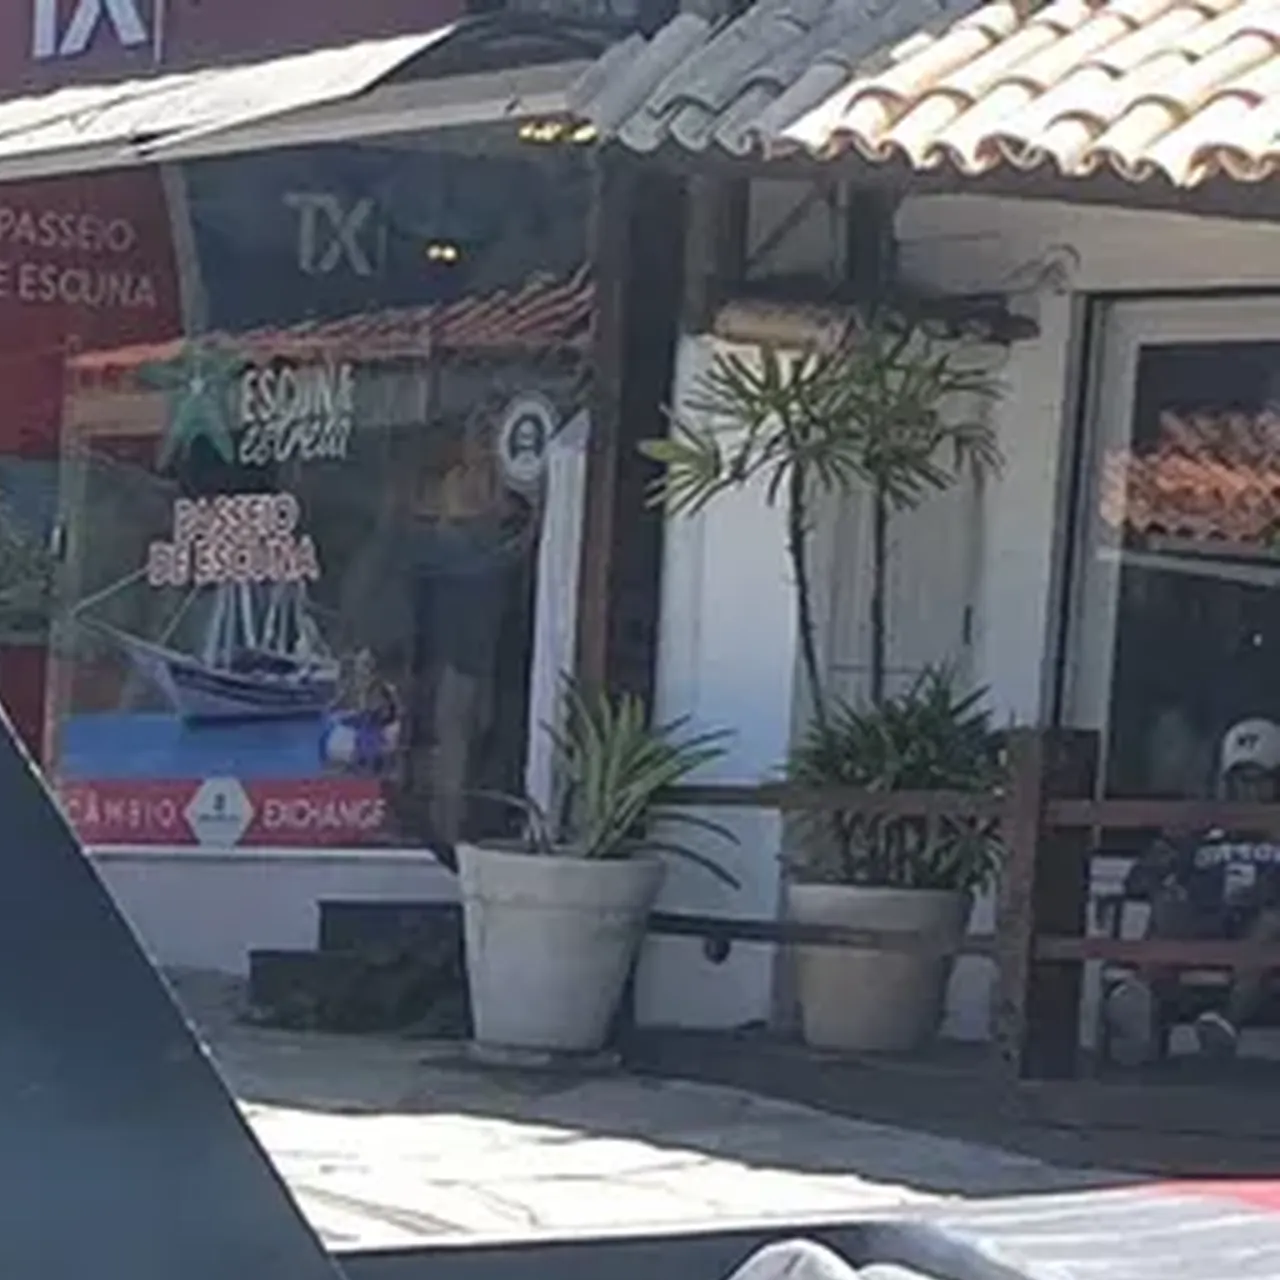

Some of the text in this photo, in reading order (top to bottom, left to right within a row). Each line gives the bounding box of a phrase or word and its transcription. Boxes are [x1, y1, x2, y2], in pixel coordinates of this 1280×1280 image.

[282, 193, 378, 277] TX
[18, 262, 156, 308] ESCUNA
[174, 492, 301, 541] PASSEIO
[148, 534, 320, 586] DE ESCUNA
[262, 798, 388, 829] EXCHANGE
